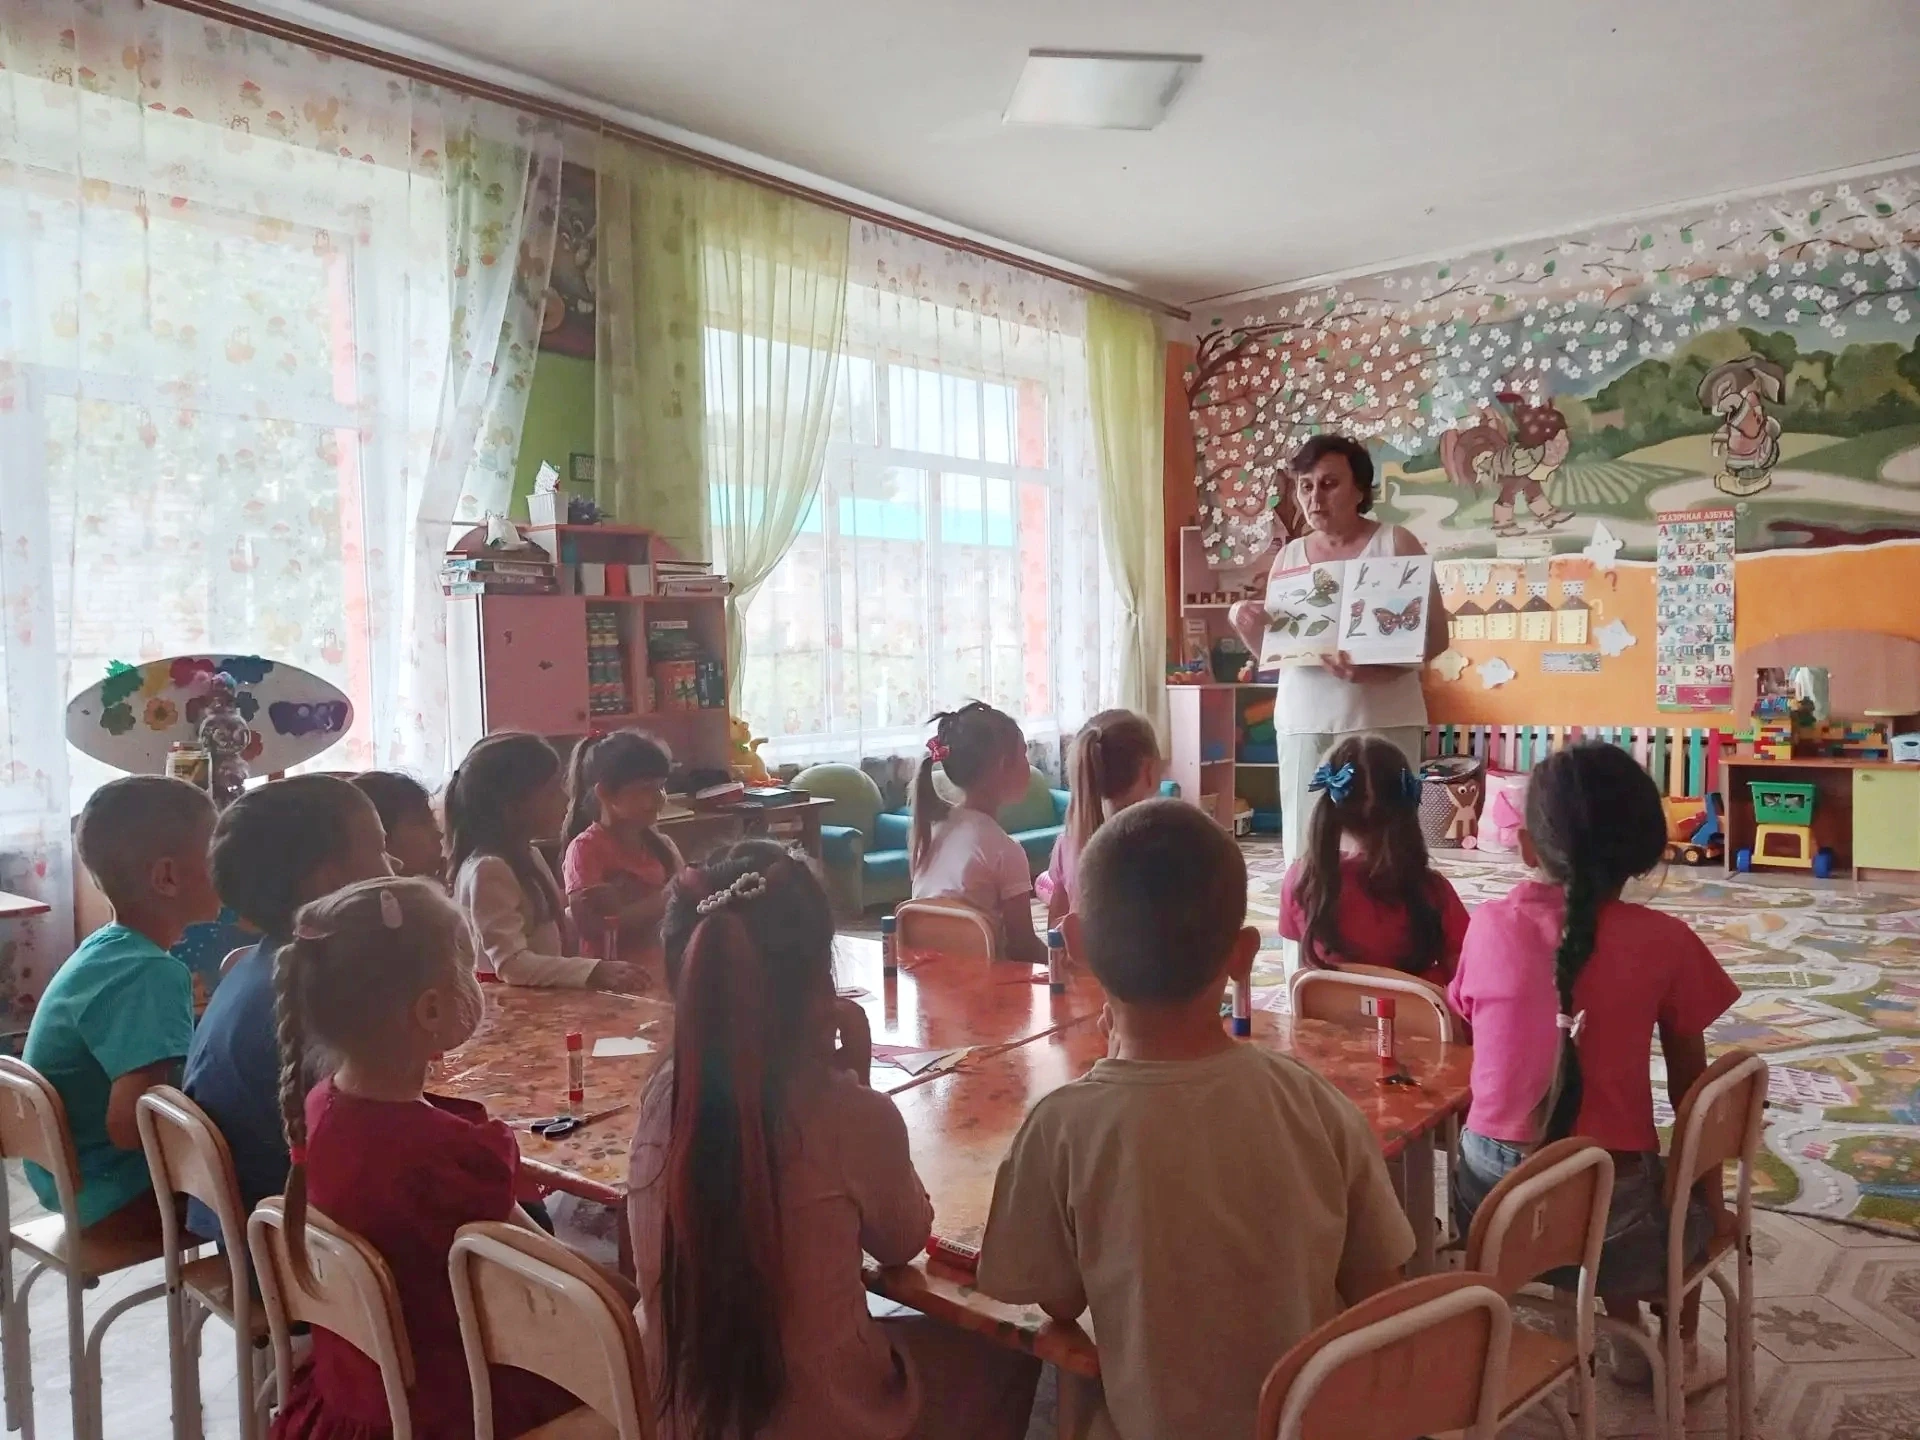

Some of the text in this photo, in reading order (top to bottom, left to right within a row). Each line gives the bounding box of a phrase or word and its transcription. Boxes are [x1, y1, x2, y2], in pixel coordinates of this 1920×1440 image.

[1659, 525, 1668, 536] А
[1715, 564, 1727, 575] К
[1696, 584, 1708, 594] Н
[1715, 583, 1727, 594] О
[1718, 645, 1731, 657] Ъ
[1695, 665, 1706, 677] Э
[1715, 664, 1733, 676] Ю
[1657, 684, 1668, 695] Я
